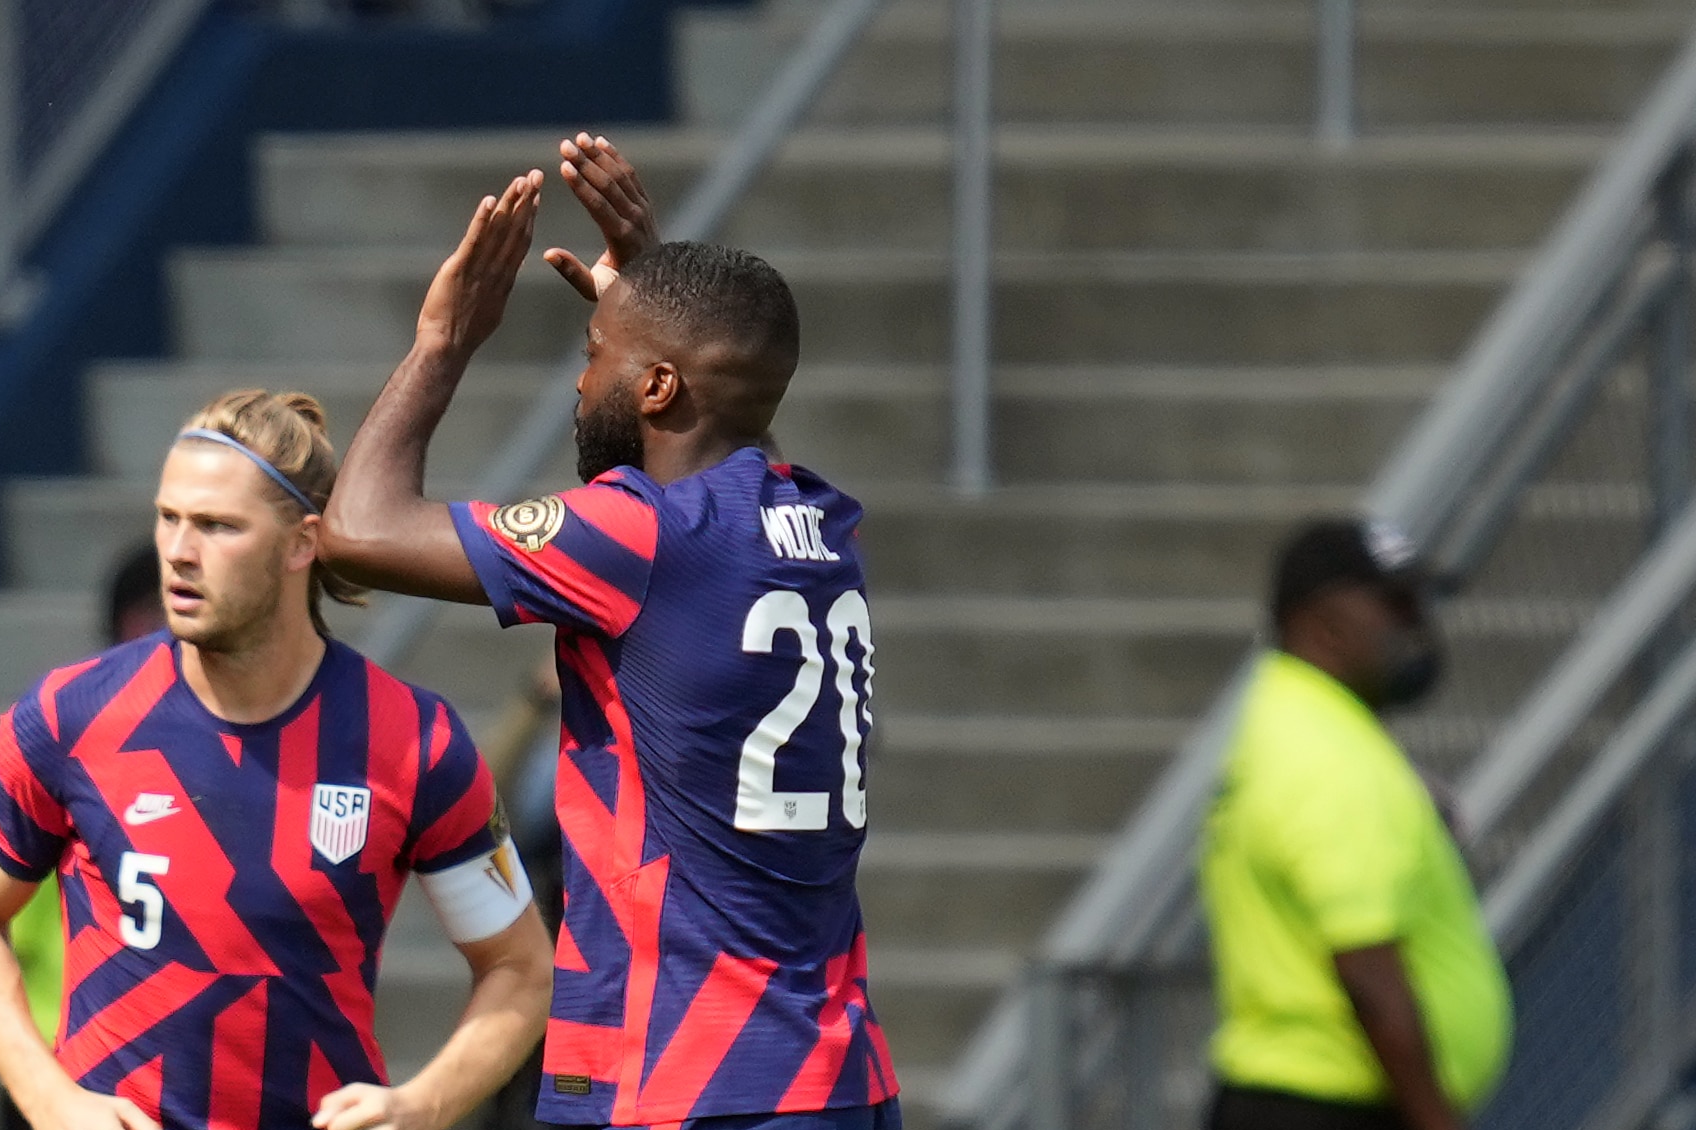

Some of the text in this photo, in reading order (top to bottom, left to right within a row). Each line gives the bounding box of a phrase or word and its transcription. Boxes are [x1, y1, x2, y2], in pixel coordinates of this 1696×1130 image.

[734, 590, 875, 830] 20
[319, 789, 364, 817] USA
[118, 851, 170, 950] 5
